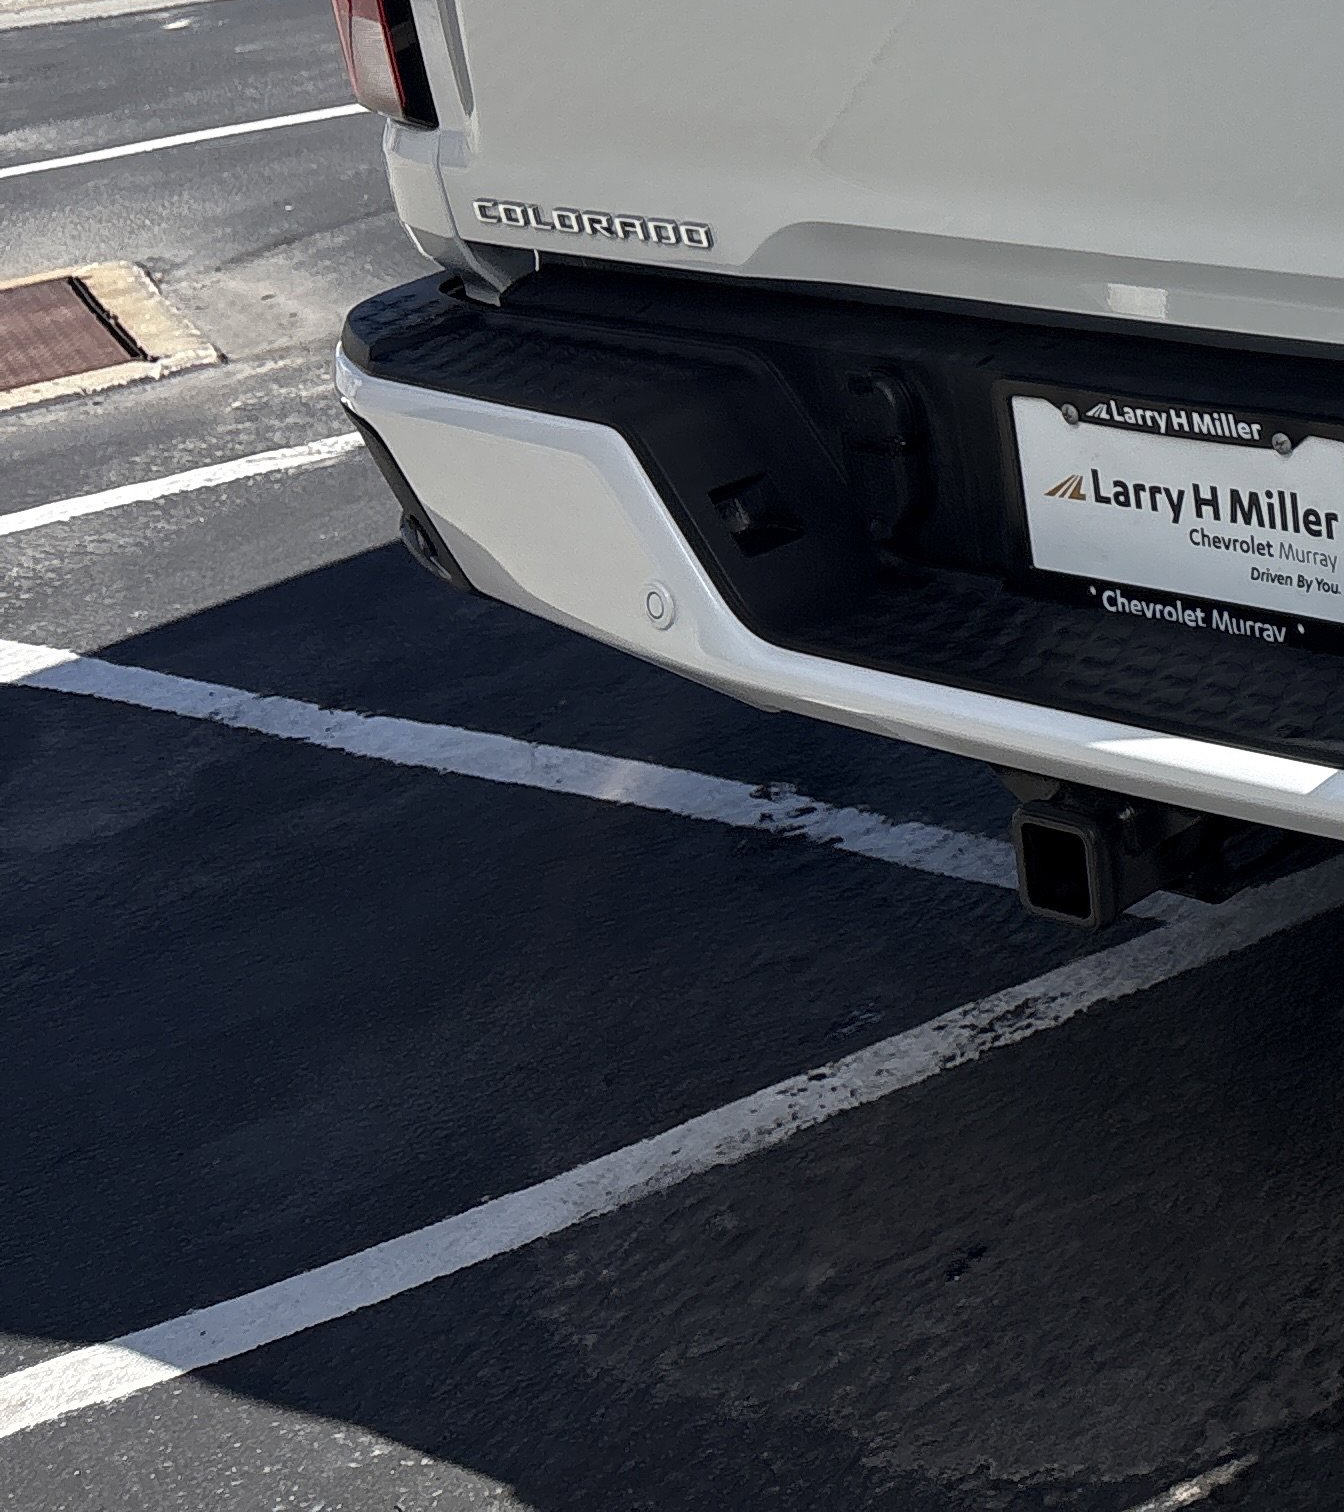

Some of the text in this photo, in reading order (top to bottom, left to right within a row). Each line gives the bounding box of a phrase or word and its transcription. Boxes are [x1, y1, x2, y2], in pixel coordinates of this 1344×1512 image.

[472, 197, 717, 249] COLORADO
[1109, 399, 1262, 442] Larry H Miller
[1089, 468, 1339, 540] Larry H Miller
[1188, 527, 1338, 573] Chevrolet Murray
[1250, 566, 1293, 588] Driven
[1296, 575, 1313, 593] By
[1102, 588, 1206, 628] Chevrolet
